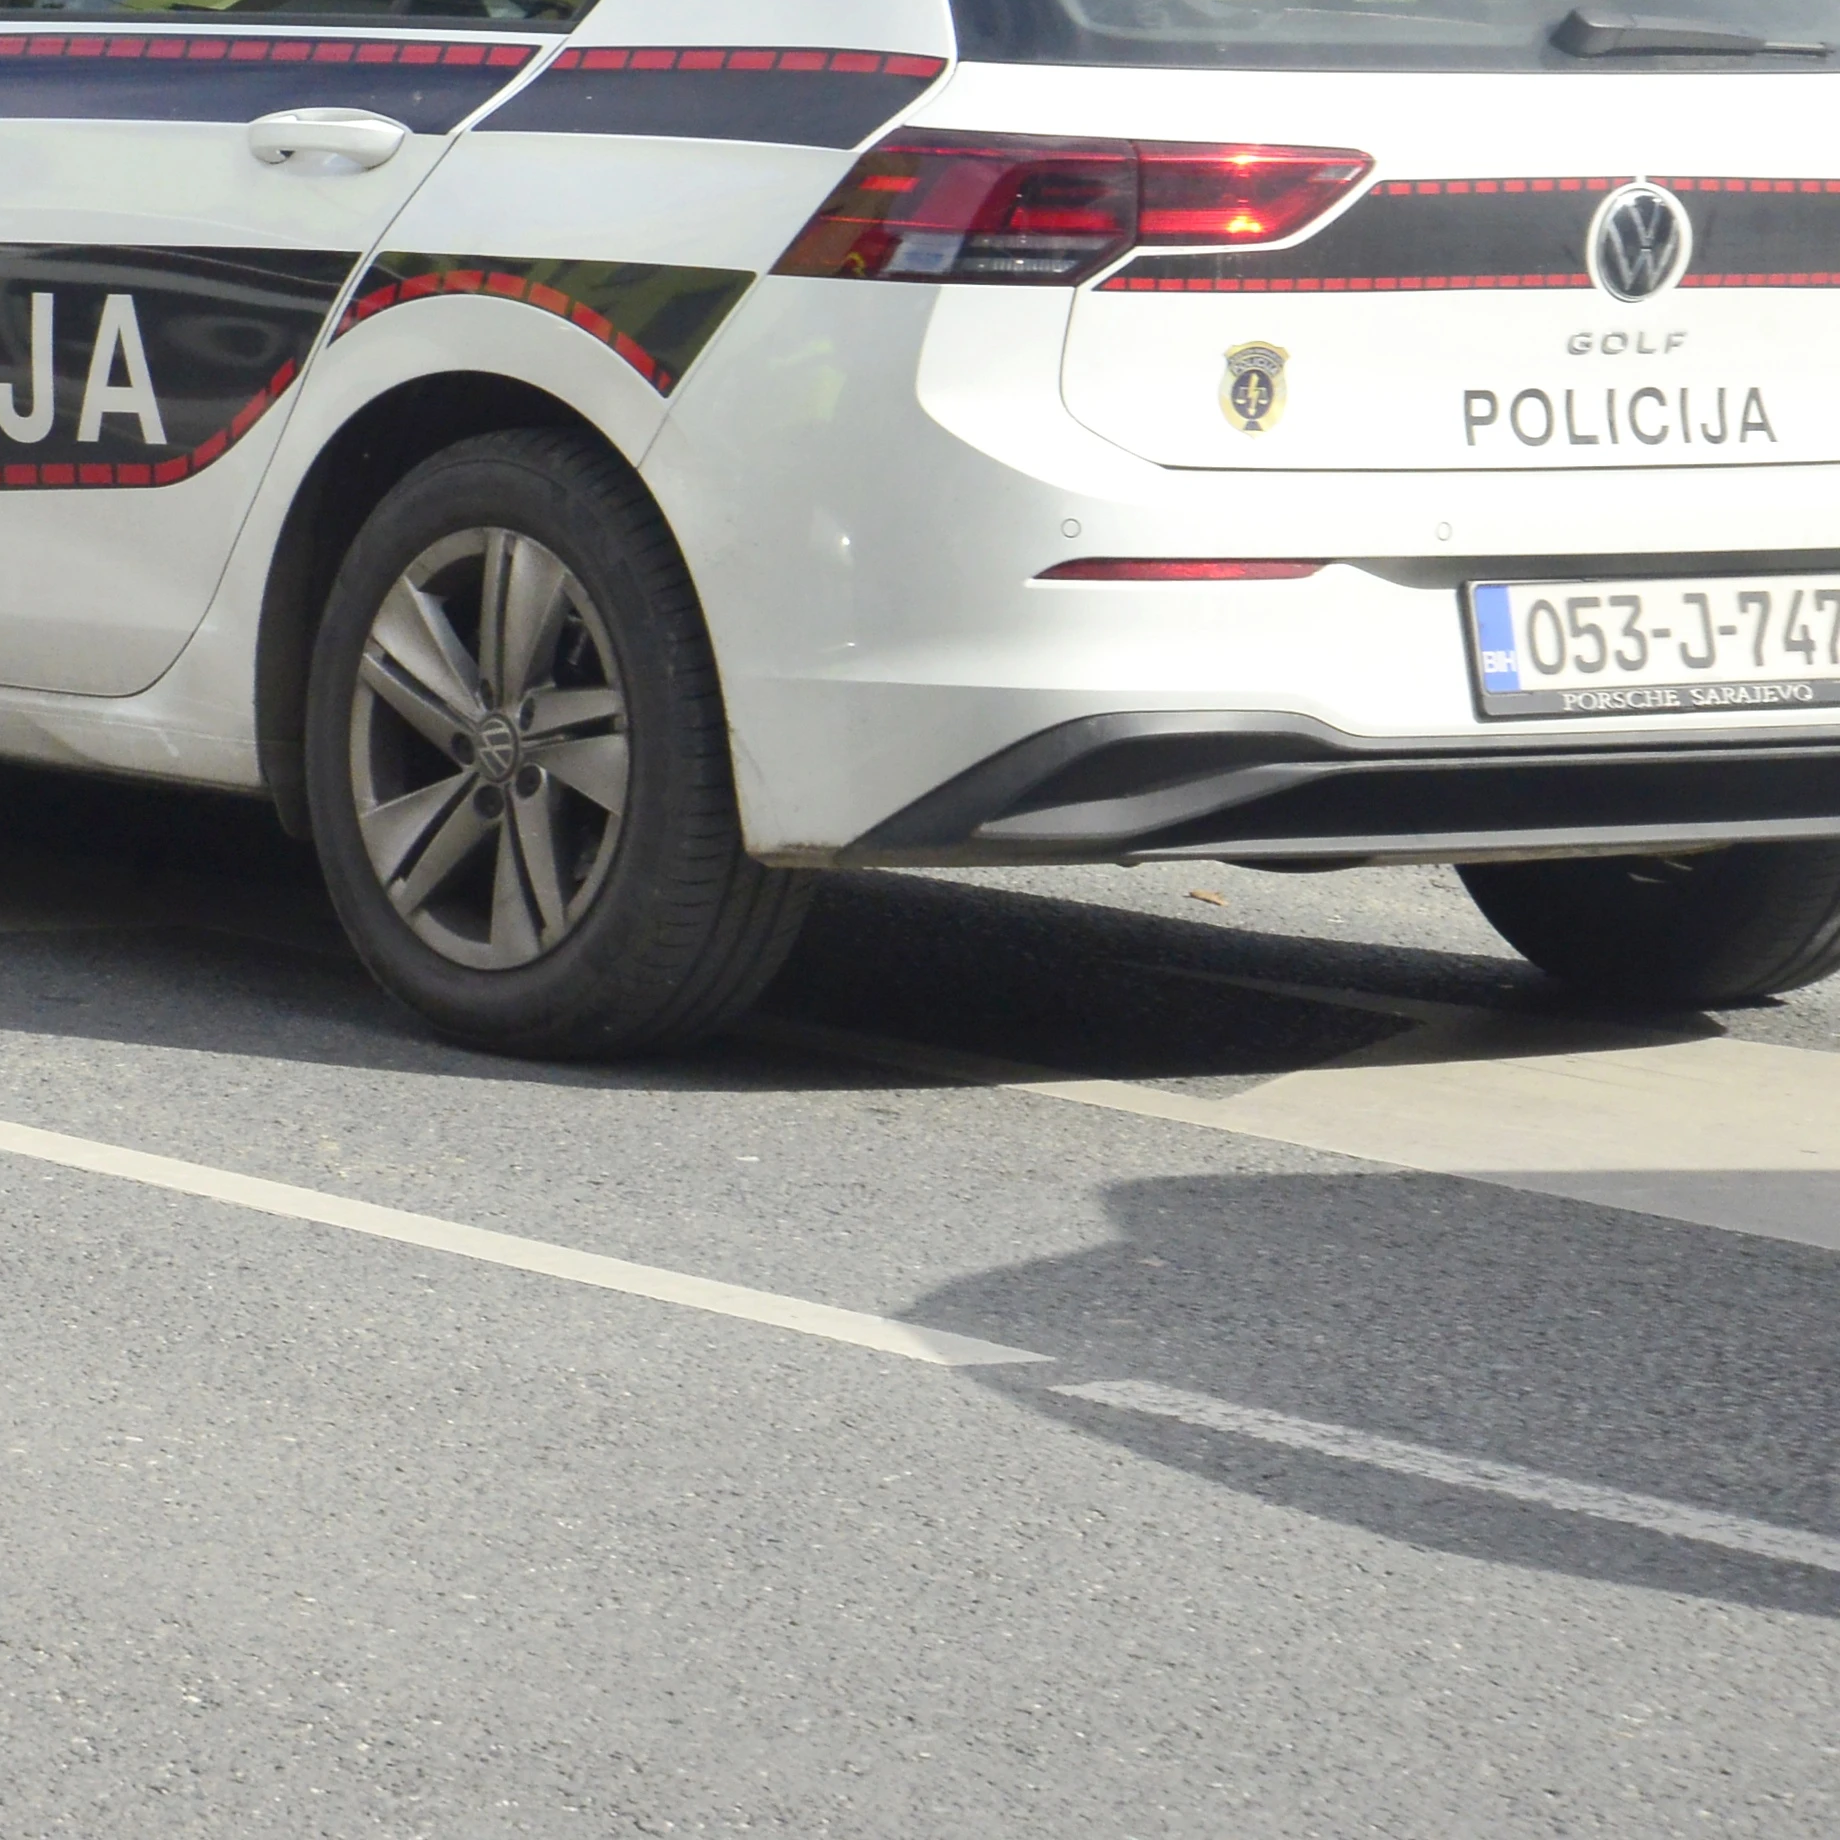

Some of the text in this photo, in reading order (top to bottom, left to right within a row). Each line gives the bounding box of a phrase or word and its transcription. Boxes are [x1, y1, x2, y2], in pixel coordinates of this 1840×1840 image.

[1566, 330, 1688, 356] GOLF
[1464, 386, 1779, 447] POLICIJA
[1482, 650, 1518, 674] BIH
[1563, 683, 1814, 711] PORSCHE SARAJEVO
